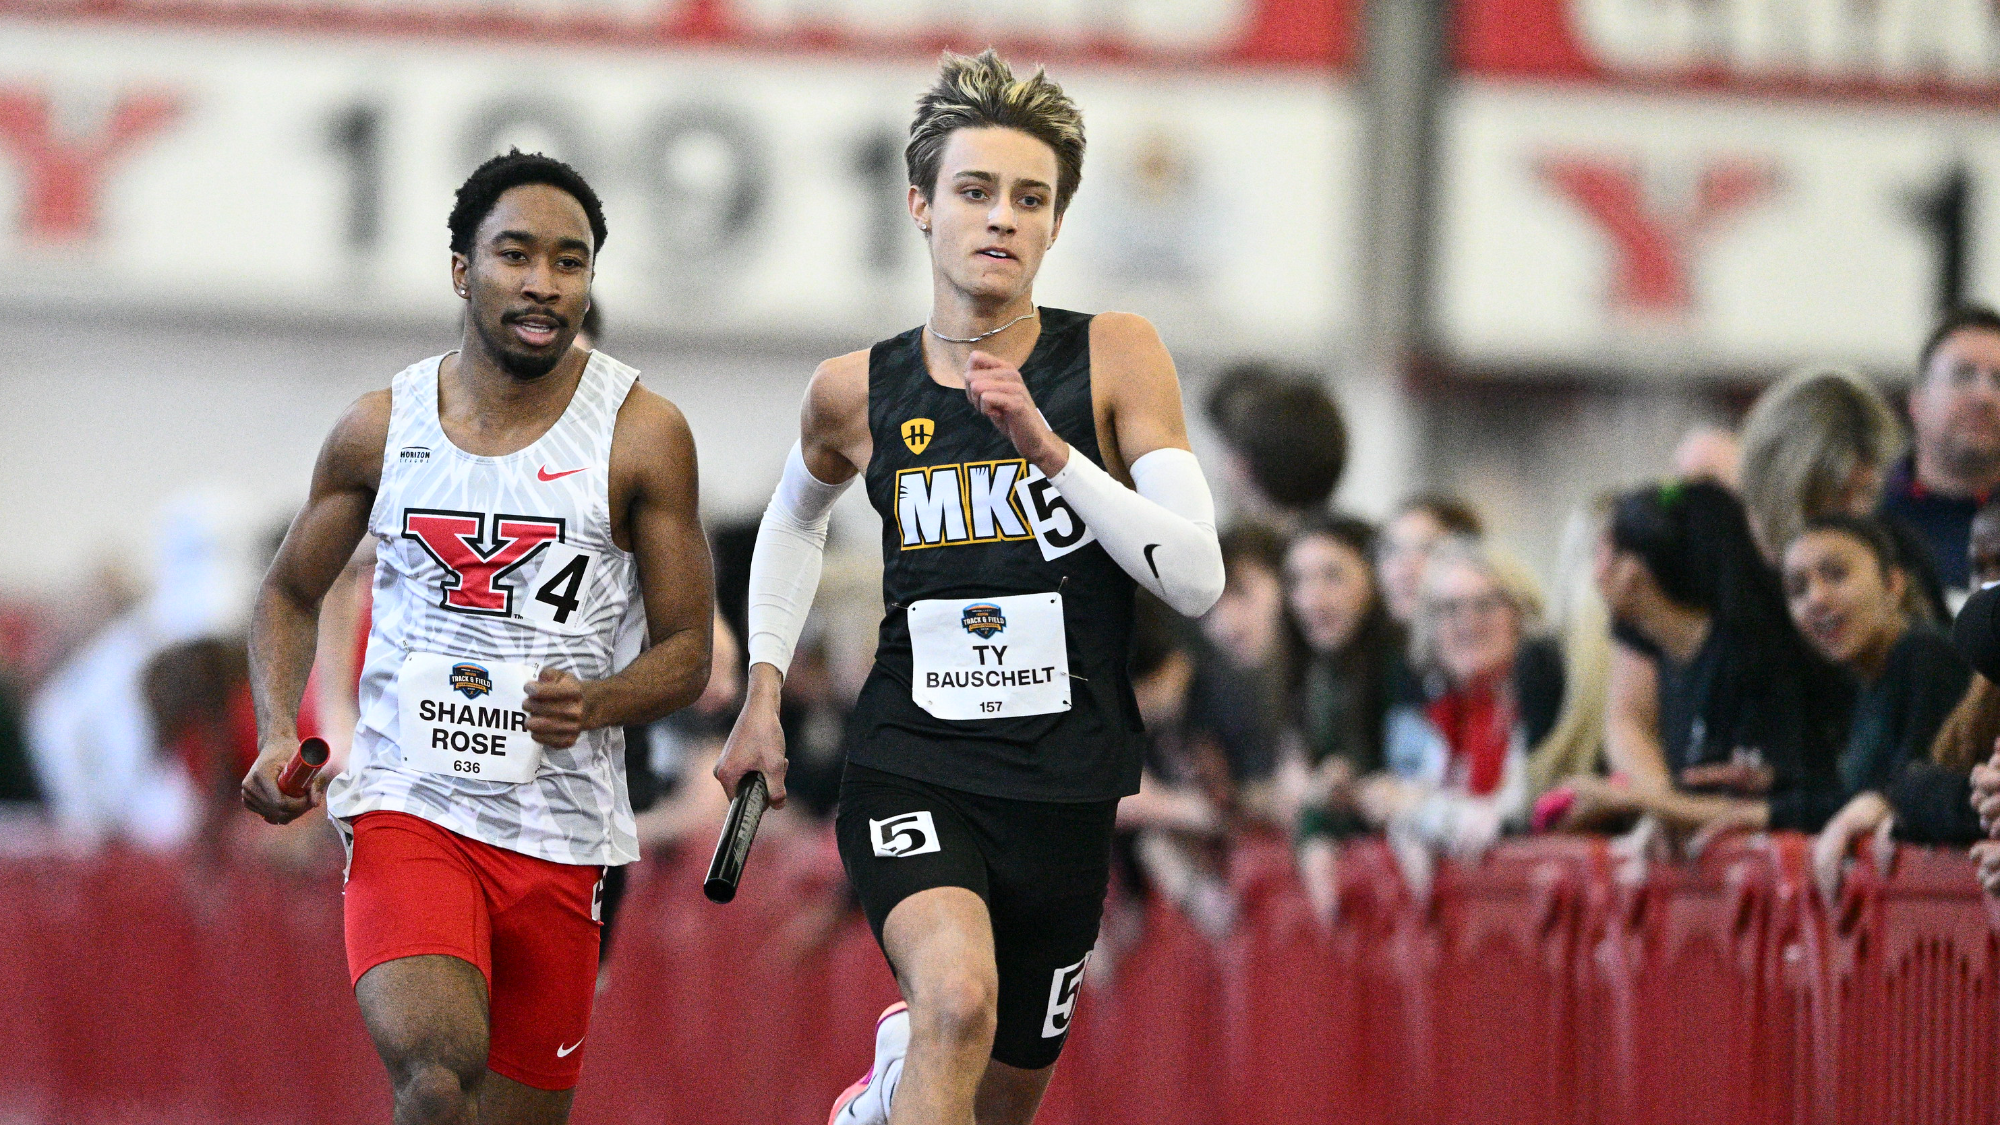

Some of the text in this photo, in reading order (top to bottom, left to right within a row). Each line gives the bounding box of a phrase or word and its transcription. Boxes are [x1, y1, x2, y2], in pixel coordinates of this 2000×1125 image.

[400, 451, 430, 459] HORIZON
[894, 458, 1040, 551] MK
[1027, 473, 1086, 549] 5
[401, 508, 566, 617] Y
[535, 554, 590, 624] 4
[963, 617, 981, 625] TRACK
[988, 616, 1005, 624] FIELD
[972, 645, 1008, 666] TY
[475, 677, 491, 688] FIELD
[926, 666, 1055, 688] BAUSCHELT
[419, 699, 528, 732] SHAMIR
[979, 701, 1003, 713] 157
[431, 728, 507, 756] ROSE
[453, 760, 481, 773] 636
[880, 816, 927, 856] 5
[1053, 958, 1086, 1029] 5
